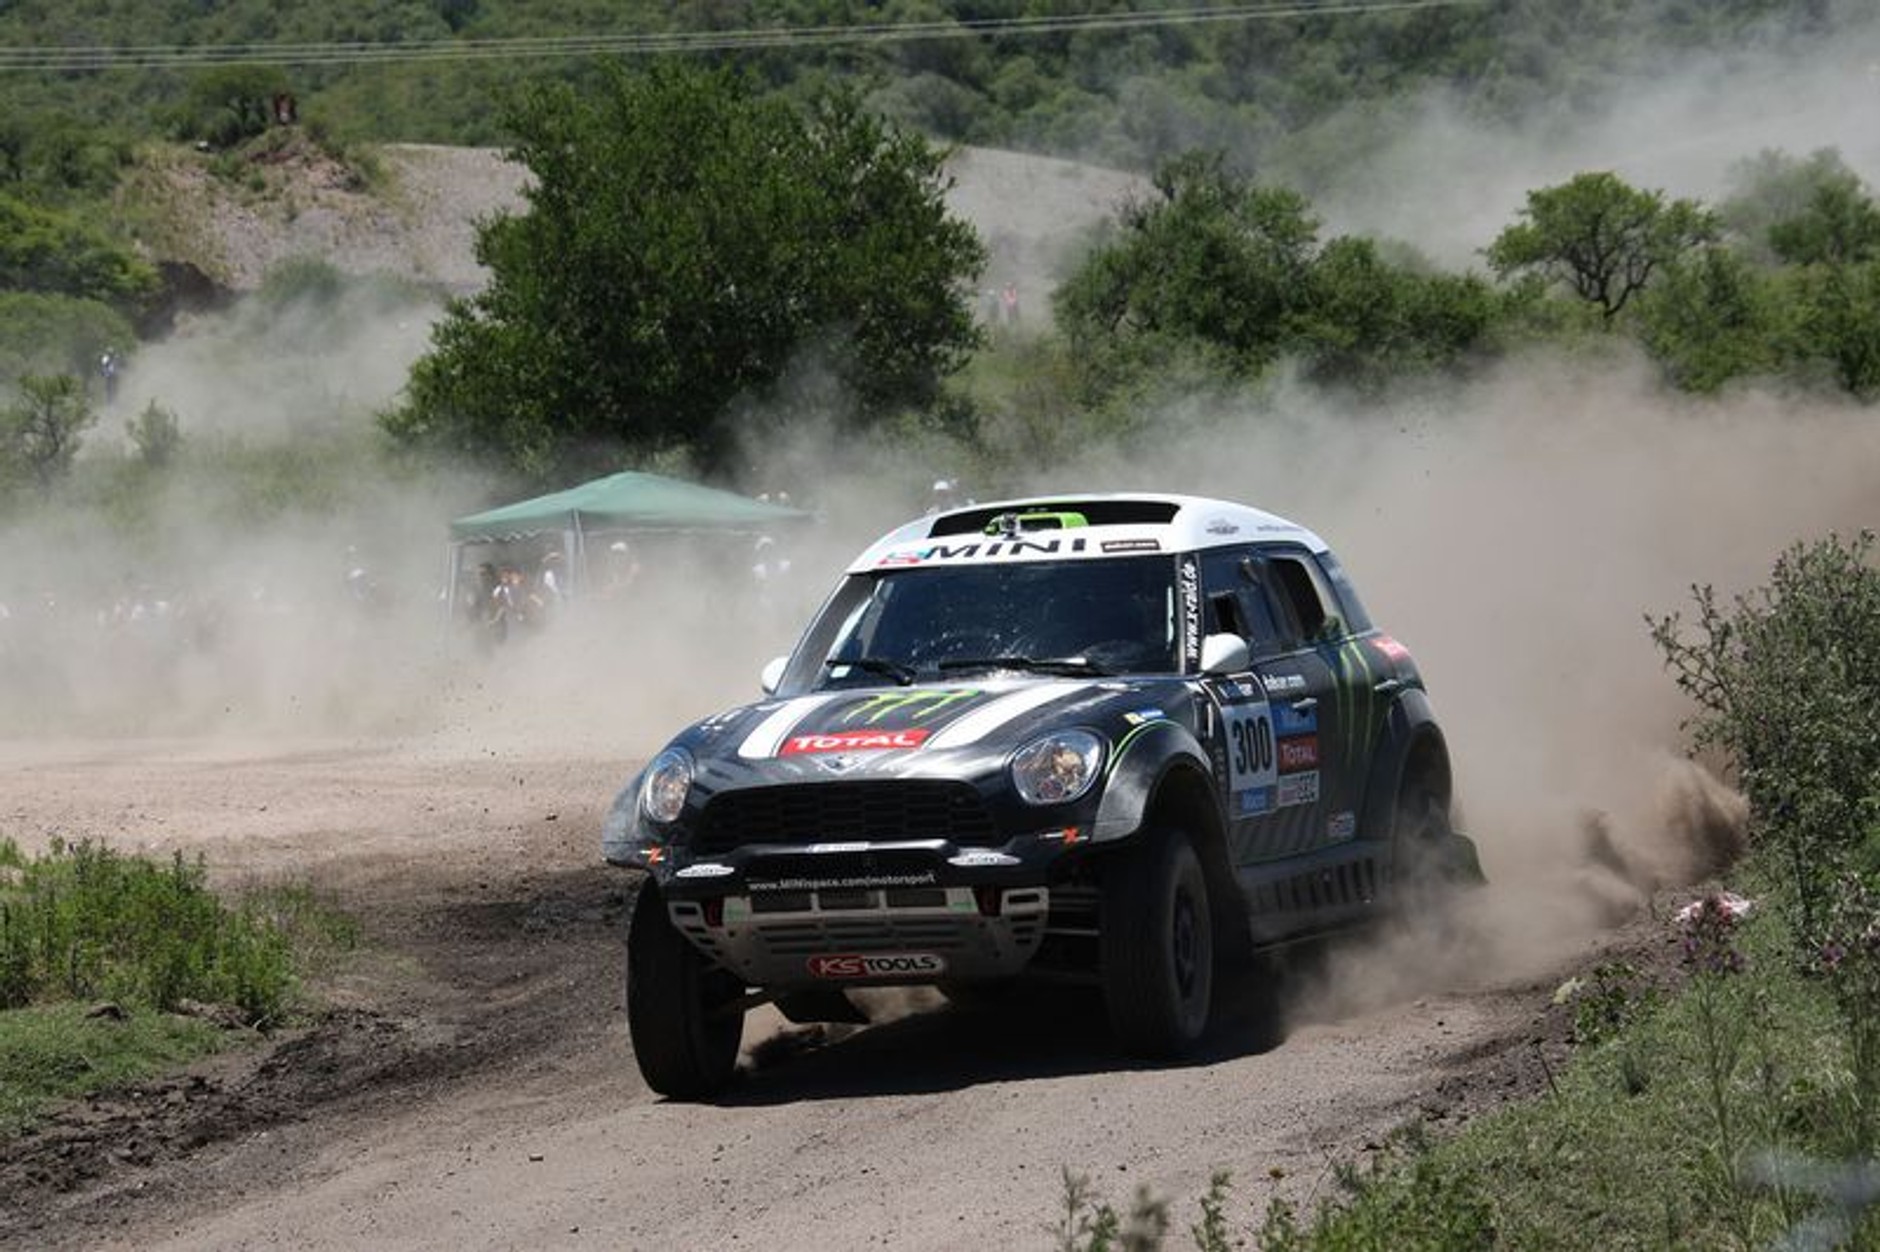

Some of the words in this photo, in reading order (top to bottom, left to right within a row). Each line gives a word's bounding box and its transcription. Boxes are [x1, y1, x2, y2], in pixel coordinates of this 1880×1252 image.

[923, 538, 1086, 560] MINI
[1181, 562, 1198, 659] www.x-raid.de
[794, 734, 916, 750] TOTAL
[1231, 716, 1273, 775] 300
[819, 958, 864, 975] KS
[865, 955, 938, 972] TOOLS
